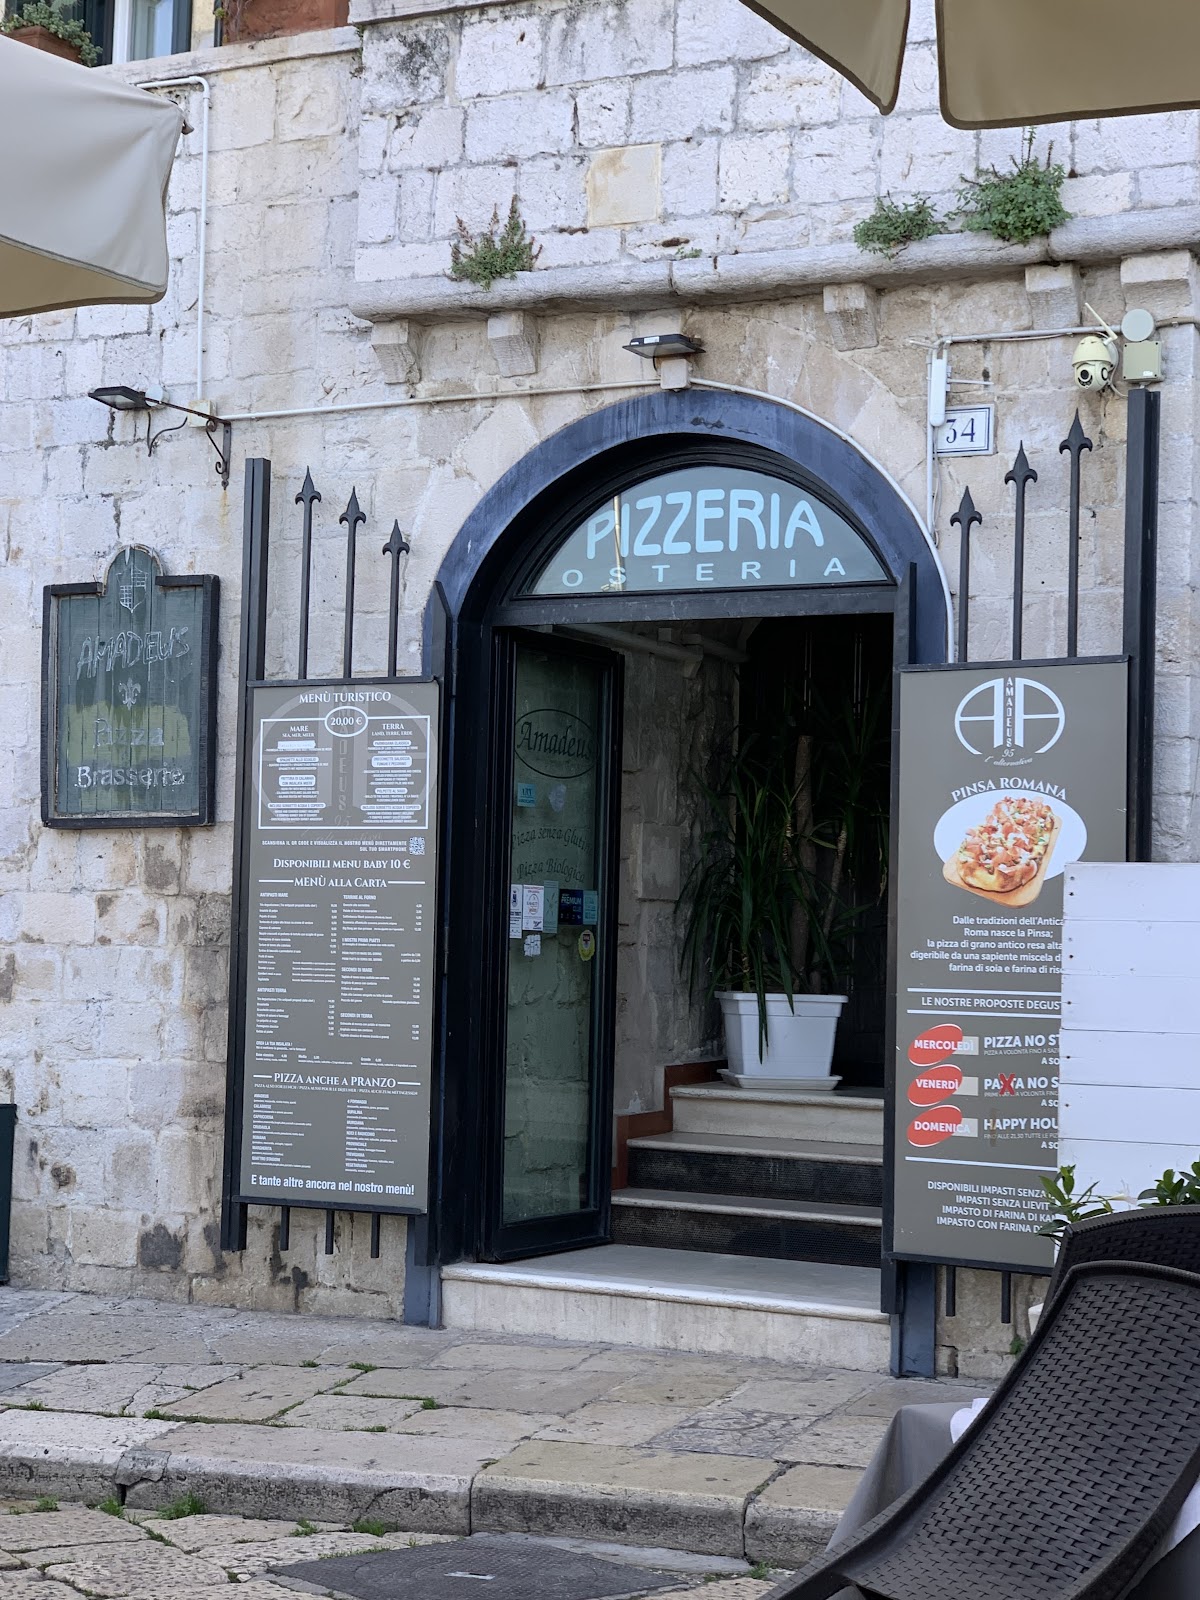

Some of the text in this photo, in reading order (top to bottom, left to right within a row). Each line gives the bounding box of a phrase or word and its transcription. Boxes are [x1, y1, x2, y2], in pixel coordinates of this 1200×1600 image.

[946, 418, 976, 443] 34
[586, 488, 825, 560] PIZZERIA
[562, 557, 847, 588] OSTERIA
[299, 691, 391, 704] MENÙ TURISTICO
[1005, 677, 1014, 748] AMADEUS
[355, 716, 363, 726] €
[516, 721, 593, 760] Amadeus
[951, 777, 1067, 802] PINSA ROMANA
[390, 858, 401, 869] 10
[402, 858, 411, 869] €
[294, 875, 326, 887] MENÙ
[328, 878, 353, 887] ALLA
[952, 915, 975, 925] Dalle
[976, 916, 1017, 926] tradizioni
[964, 928, 1053, 939] Roma nasce la Pinsa;
[927, 939, 935, 947] la
[936, 940, 959, 949] pizza
[960, 939, 969, 948] di
[970, 942, 996, 950] grano
[998, 940, 1026, 949] antico
[1027, 942, 1045, 950] resa
[910, 950, 950, 961] digeribile
[951, 951, 962, 960] da
[963, 953, 980, 961] una
[981, 953, 1019, 962] sapiente
[1020, 952, 1053, 962] miscela
[949, 963, 974, 972] farina
[975, 963, 984, 972] di
[985, 964, 1003, 973] soia
[1012, 964, 1037, 973] farina
[1039, 965, 1048, 974] di
[921, 997, 932, 1006] LE
[934, 997, 972, 1008] NOSTRE
[973, 998, 1025, 1009] PROPOSTE
[914, 1038, 974, 1051] MERCOLEDÌ
[984, 1037, 1022, 1049] PIZZA
[1024, 1035, 1046, 1047] NO
[1041, 1057, 1060, 1065] A SO
[274, 1072, 304, 1084] PIZZA
[305, 1075, 340, 1085] ANCHE
[351, 1076, 396, 1088] PRANZO
[915, 1078, 959, 1090] VENERDÌ
[984, 1076, 1059, 1090] PAA NO S
[1041, 1099, 1048, 1107] A
[914, 1120, 971, 1134] DOMENICA
[984, 1117, 1027, 1130] HAPPY
[1041, 1141, 1048, 1149] A
[251, 1174, 415, 1196] E tante altre ancora nel nostro menù!
[927, 1181, 979, 1193] DISPONIBILI
[980, 1185, 1016, 1196] IMPASTI
[1017, 1188, 1046, 1198] SENZA
[956, 1195, 1050, 1211] IMPASTI SENZA LIEVIT
[942, 1205, 981, 1217] IMPASTO
[982, 1208, 992, 1217] DI
[994, 1210, 1026, 1221] FARINA
[1027, 1212, 1038, 1222] DI
[936, 1216, 1043, 1234] IMPASTO CON FARINA D
